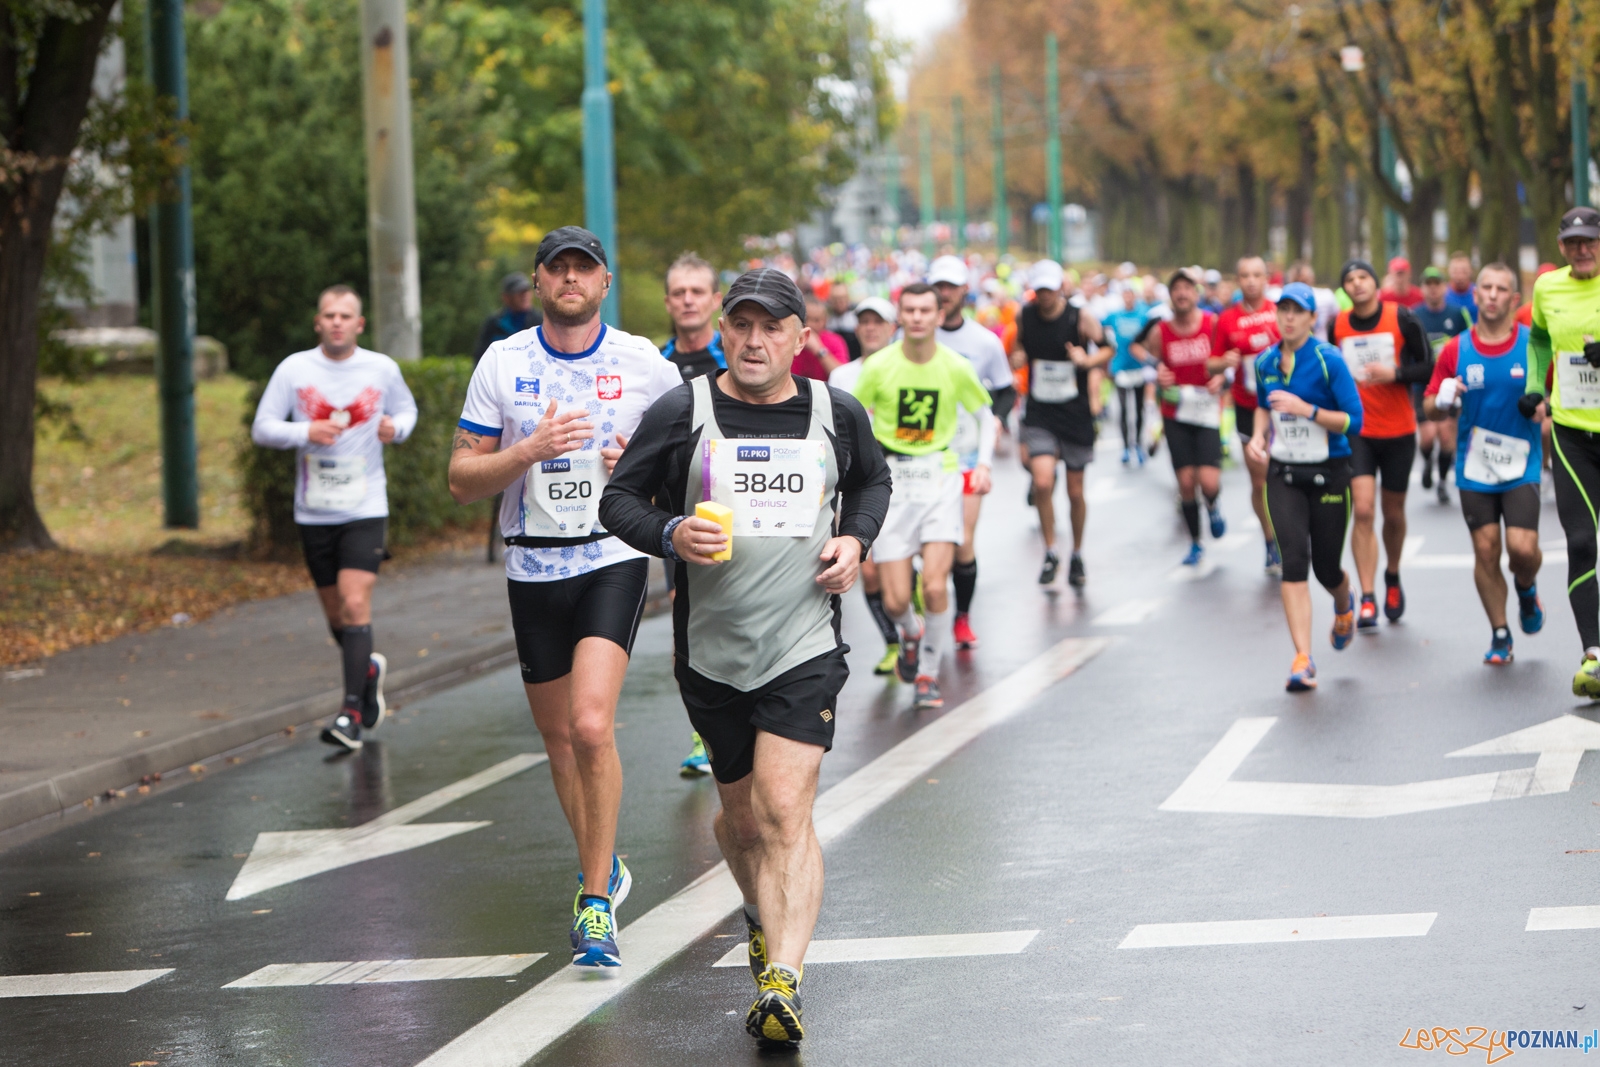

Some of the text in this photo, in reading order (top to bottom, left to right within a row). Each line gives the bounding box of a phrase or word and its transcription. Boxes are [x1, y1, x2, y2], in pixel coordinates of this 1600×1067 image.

[514, 400, 542, 408] DARIUSZ
[1284, 426, 1310, 438] 1371
[734, 473, 804, 493] 3840
[548, 480, 592, 500] 620
[555, 504, 587, 513] Dariusz
[749, 499, 788, 508] Dariusz
